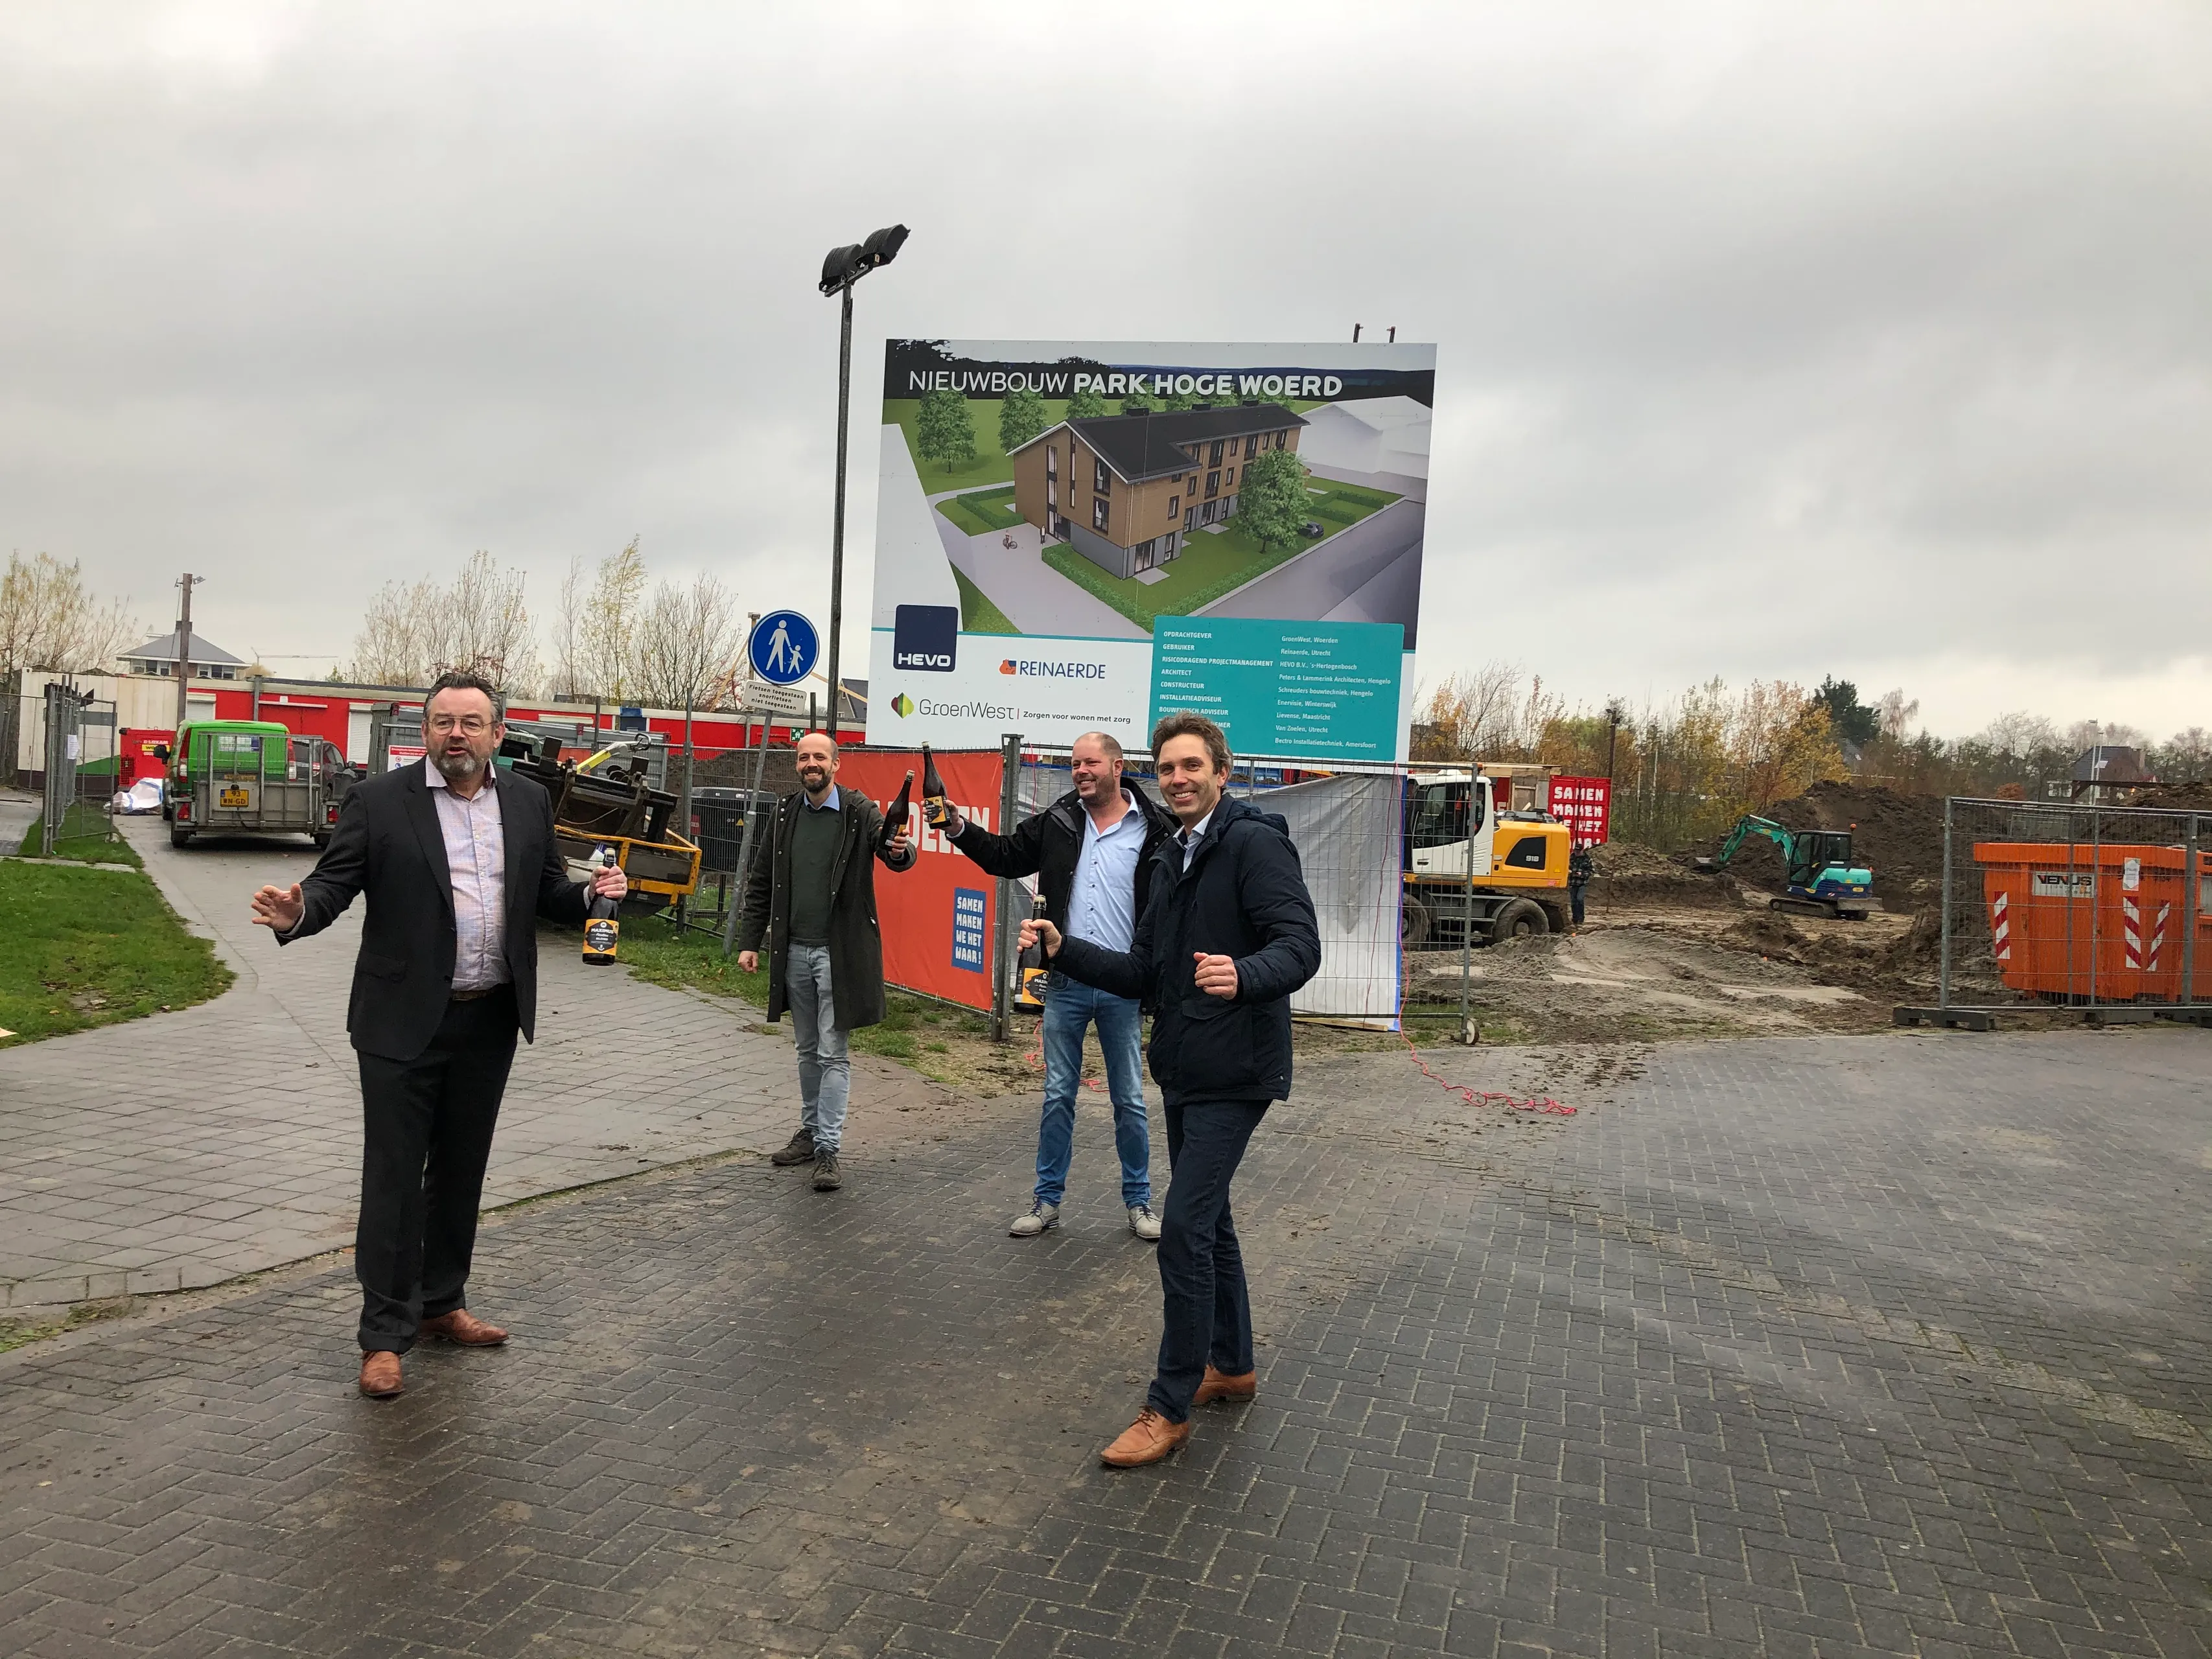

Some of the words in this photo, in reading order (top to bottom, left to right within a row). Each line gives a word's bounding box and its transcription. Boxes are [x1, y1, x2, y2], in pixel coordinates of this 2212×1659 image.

[909, 370, 1069, 392] NIEUWBOUW
[1073, 373, 1148, 394] PARK
[1154, 373, 1233, 395] HOGE
[1239, 375, 1343, 397] WOERD
[898, 652, 951, 667] HEVO
[1209, 658, 1274, 667] PROJECTMANAGEMENT
[1019, 660, 1106, 679] REINAERDE
[749, 684, 771, 693] Fietsen
[773, 689, 804, 699] toegestaan
[759, 693, 792, 703] snorfietsen
[1159, 694, 1222, 702] INSTALLATIEADVISEUR
[1309, 688, 1349, 696] bouwtechniek,
[765, 701, 797, 710] toegestaan
[919, 699, 1014, 720] GroenWest
[1023, 710, 1050, 720] Zorgen
[1113, 716, 1131, 725] zorg
[1293, 739, 1344, 747] Installatietechniek,
[1554, 786, 1604, 801] SAMEN
[1552, 803, 1603, 817] MAKEN
[1575, 820, 1602, 832] HET
[2037, 874, 2092, 886] VENUS
[957, 896, 983, 913] SAMEN
[956, 912, 983, 931] MAKEN
[956, 929, 966, 944] WE
[967, 932, 982, 947] HET
[955, 946, 981, 964] WAAR!
